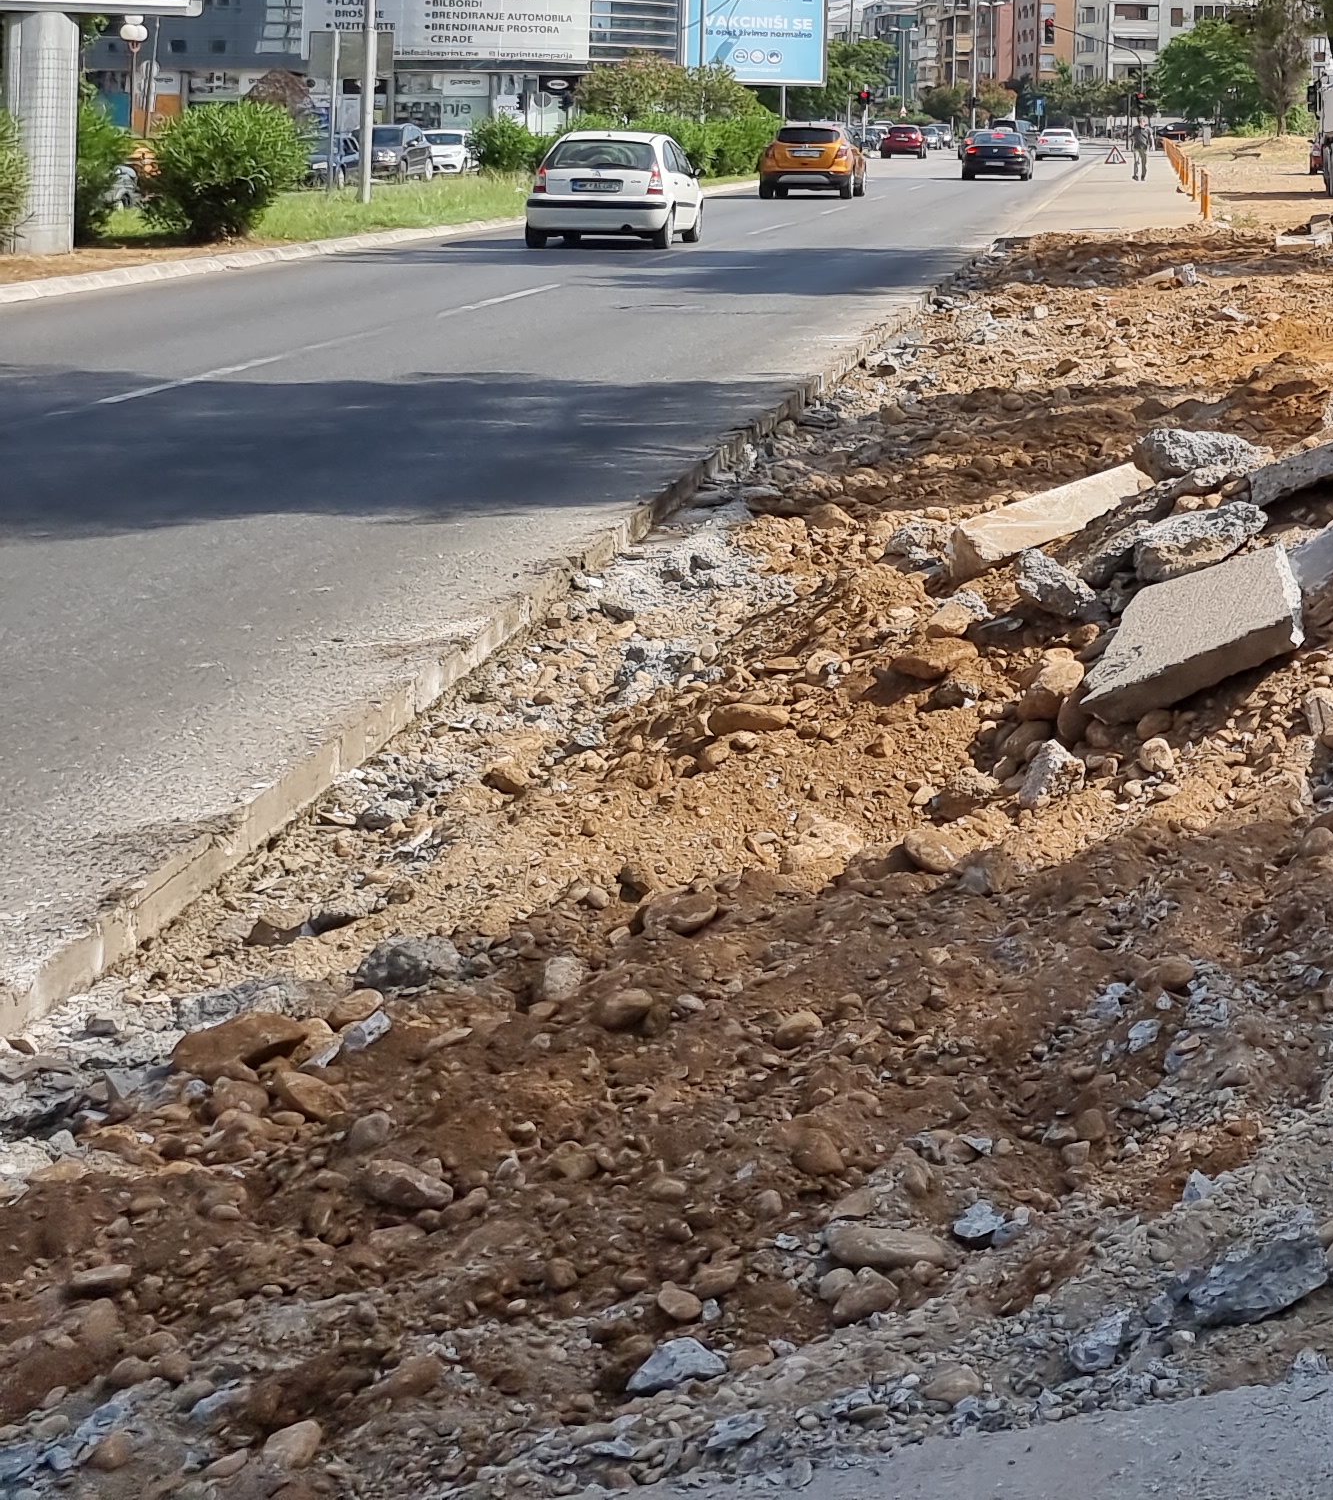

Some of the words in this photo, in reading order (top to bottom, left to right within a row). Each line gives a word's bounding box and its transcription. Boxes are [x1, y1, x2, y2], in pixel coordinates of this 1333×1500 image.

[432, 0, 482, 8] BILBORDI
[431, 11, 505, 21] BRENDIRANJE
[507, 12, 572, 23] AUTOMOBILA
[431, 23, 504, 33] BRENDIRANJE
[507, 25, 560, 34] PROSTORA
[792, 18, 813, 30] SE
[430, 35, 474, 44] CERADE
